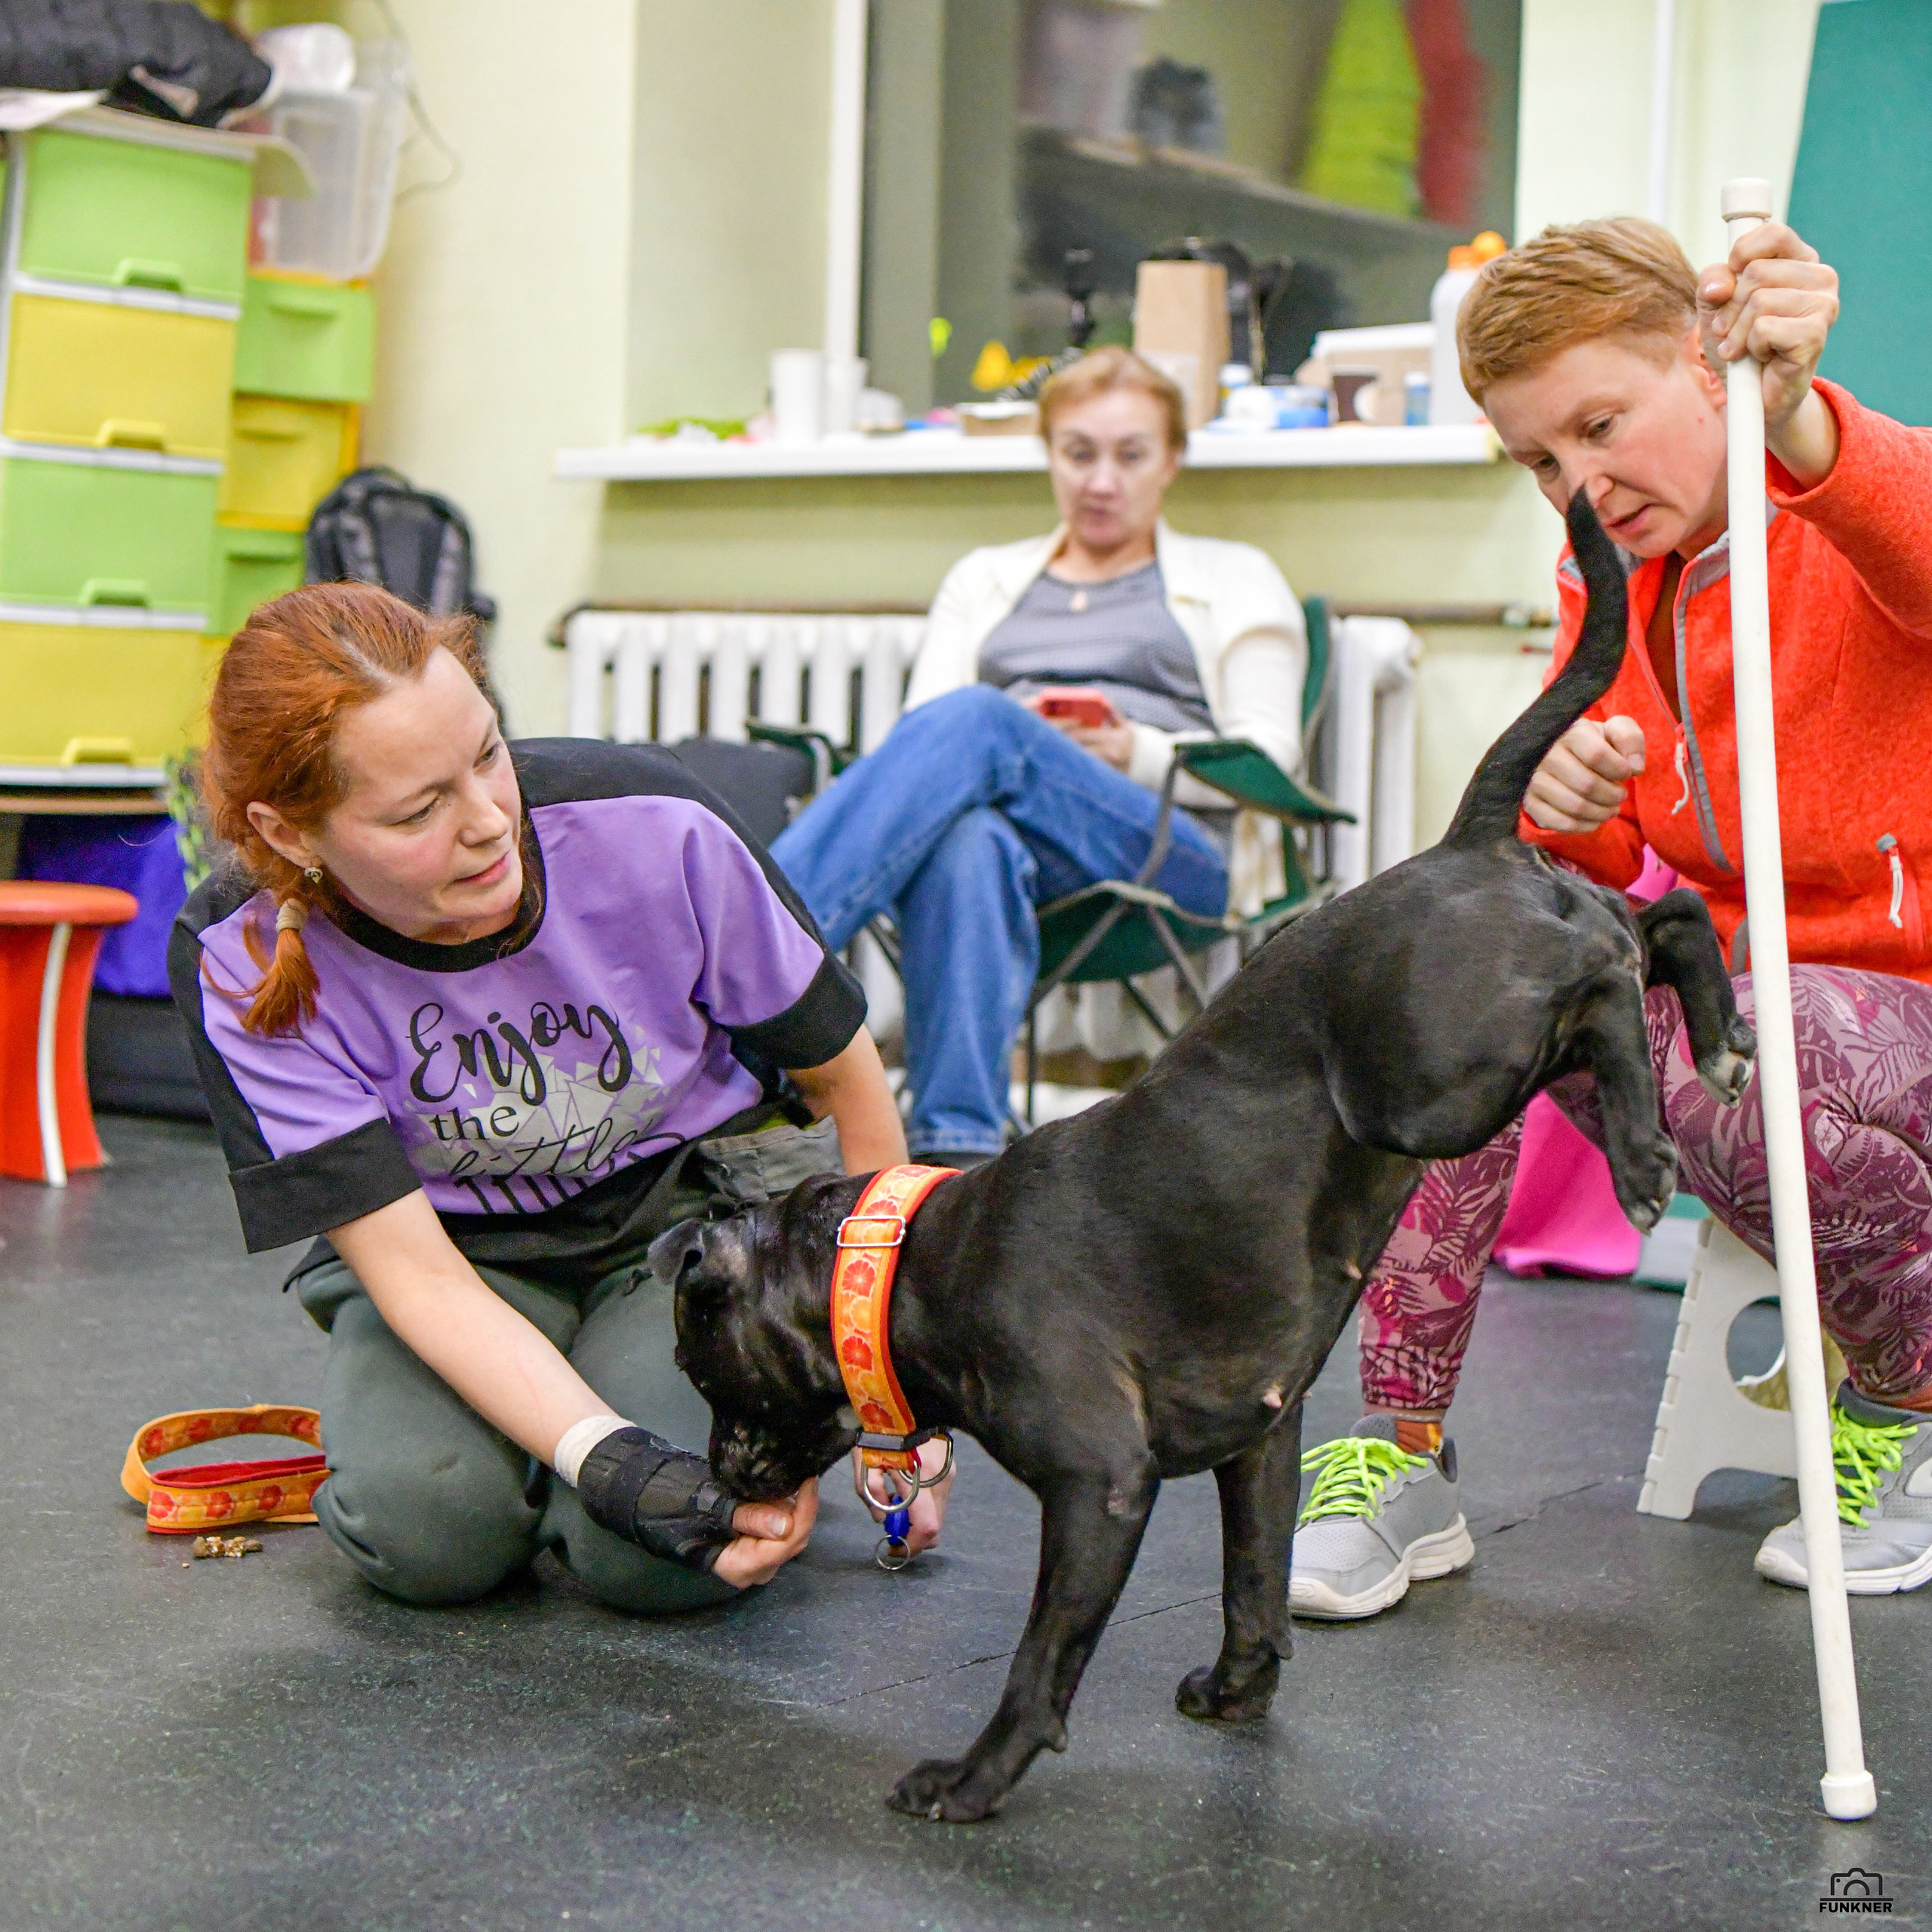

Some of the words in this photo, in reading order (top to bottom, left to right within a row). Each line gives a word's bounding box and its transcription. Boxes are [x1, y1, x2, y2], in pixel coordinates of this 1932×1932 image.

[405, 1001, 633, 1106] Enjoy
[429, 1105, 520, 1141] the
[451, 1117, 653, 1179] lttle
